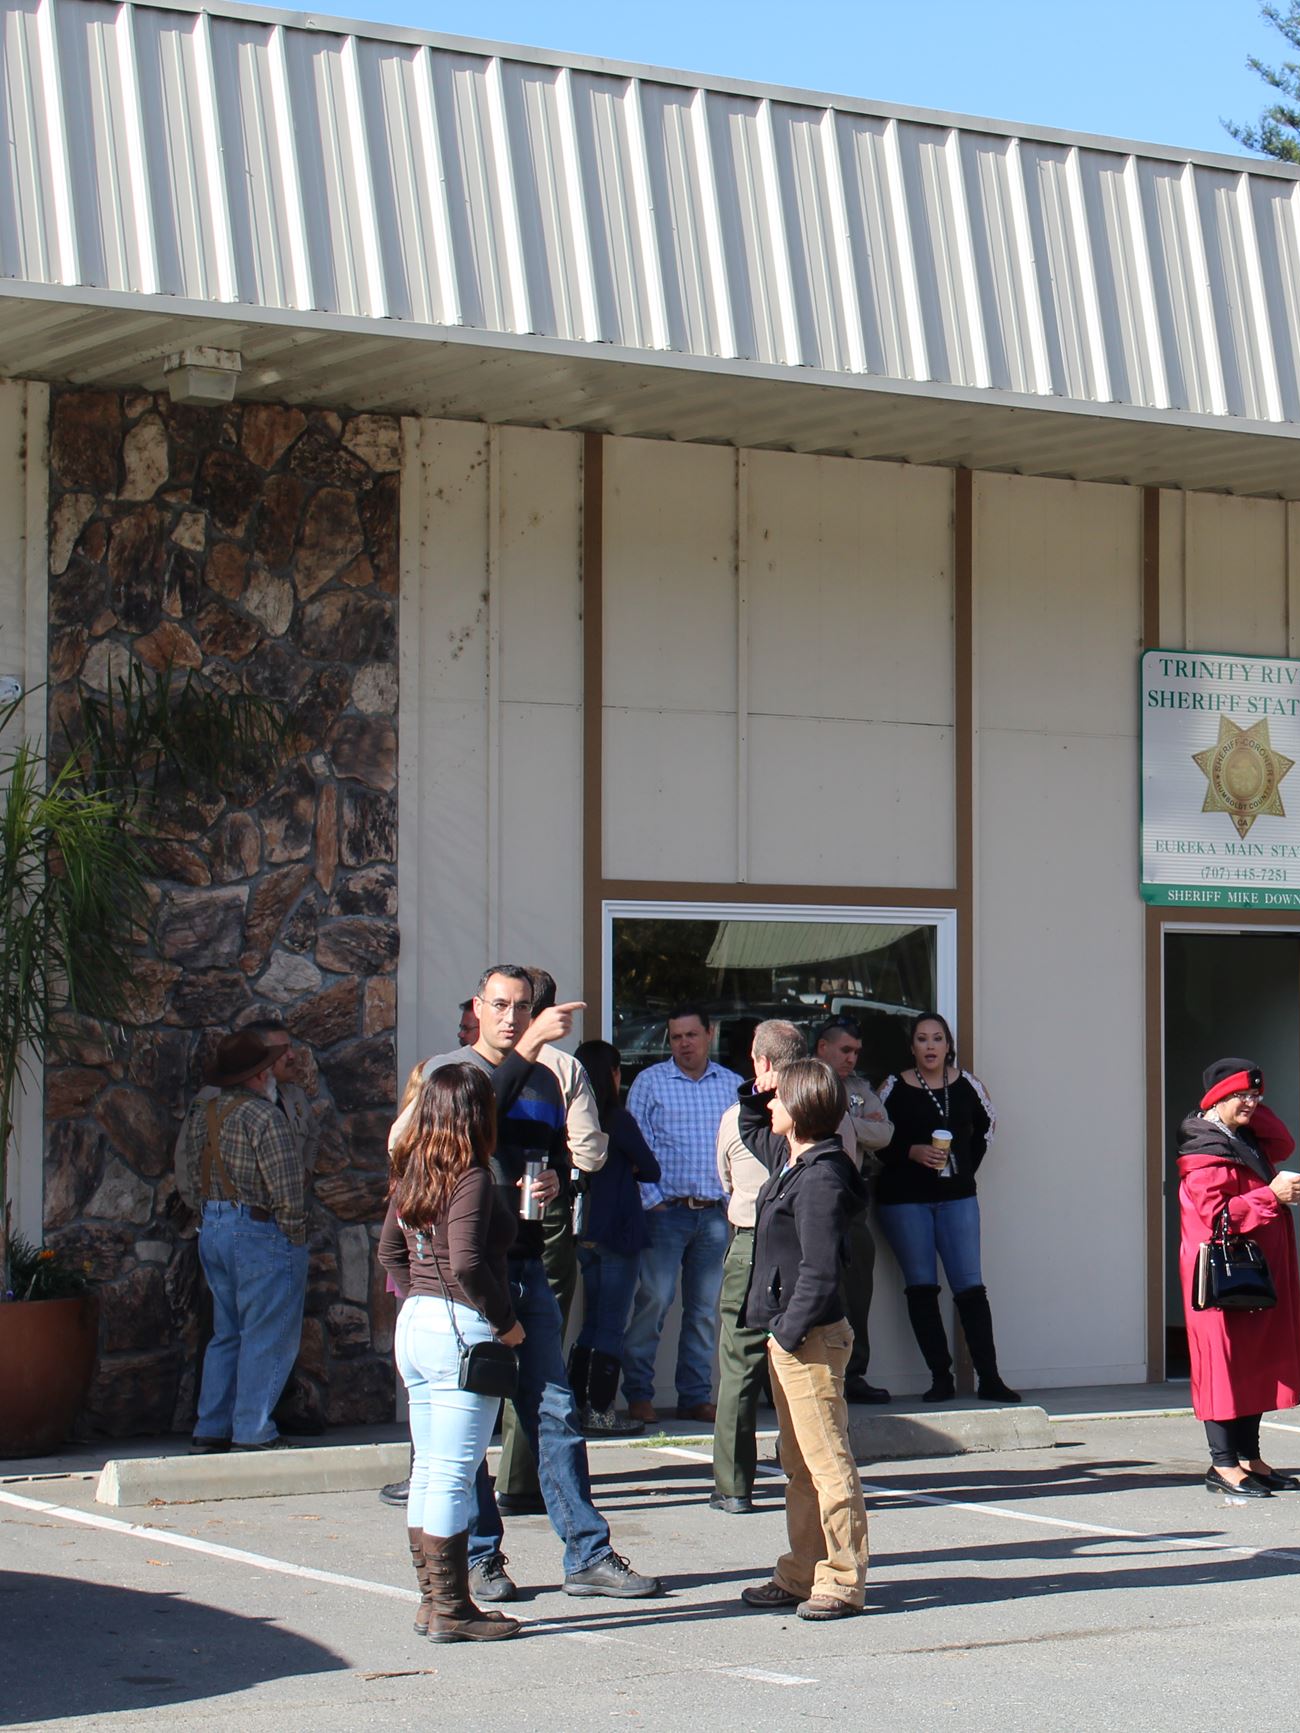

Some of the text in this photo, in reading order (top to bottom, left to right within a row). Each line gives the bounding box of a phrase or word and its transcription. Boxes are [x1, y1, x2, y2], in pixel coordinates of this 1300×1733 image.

[1159, 658, 1253, 683] TRINITY
[1148, 690, 1242, 713] SHERIFF
[1216, 781, 1247, 811] HUMBOLDT
[1237, 818, 1248, 827] CA
[1155, 839, 1217, 855] EUREKA
[1224, 842, 1264, 857] MAIN
[1200, 867, 1288, 882] (707) 445-7251
[1167, 890, 1221, 903] SHERIFF
[1227, 891, 1259, 904] MIKE
